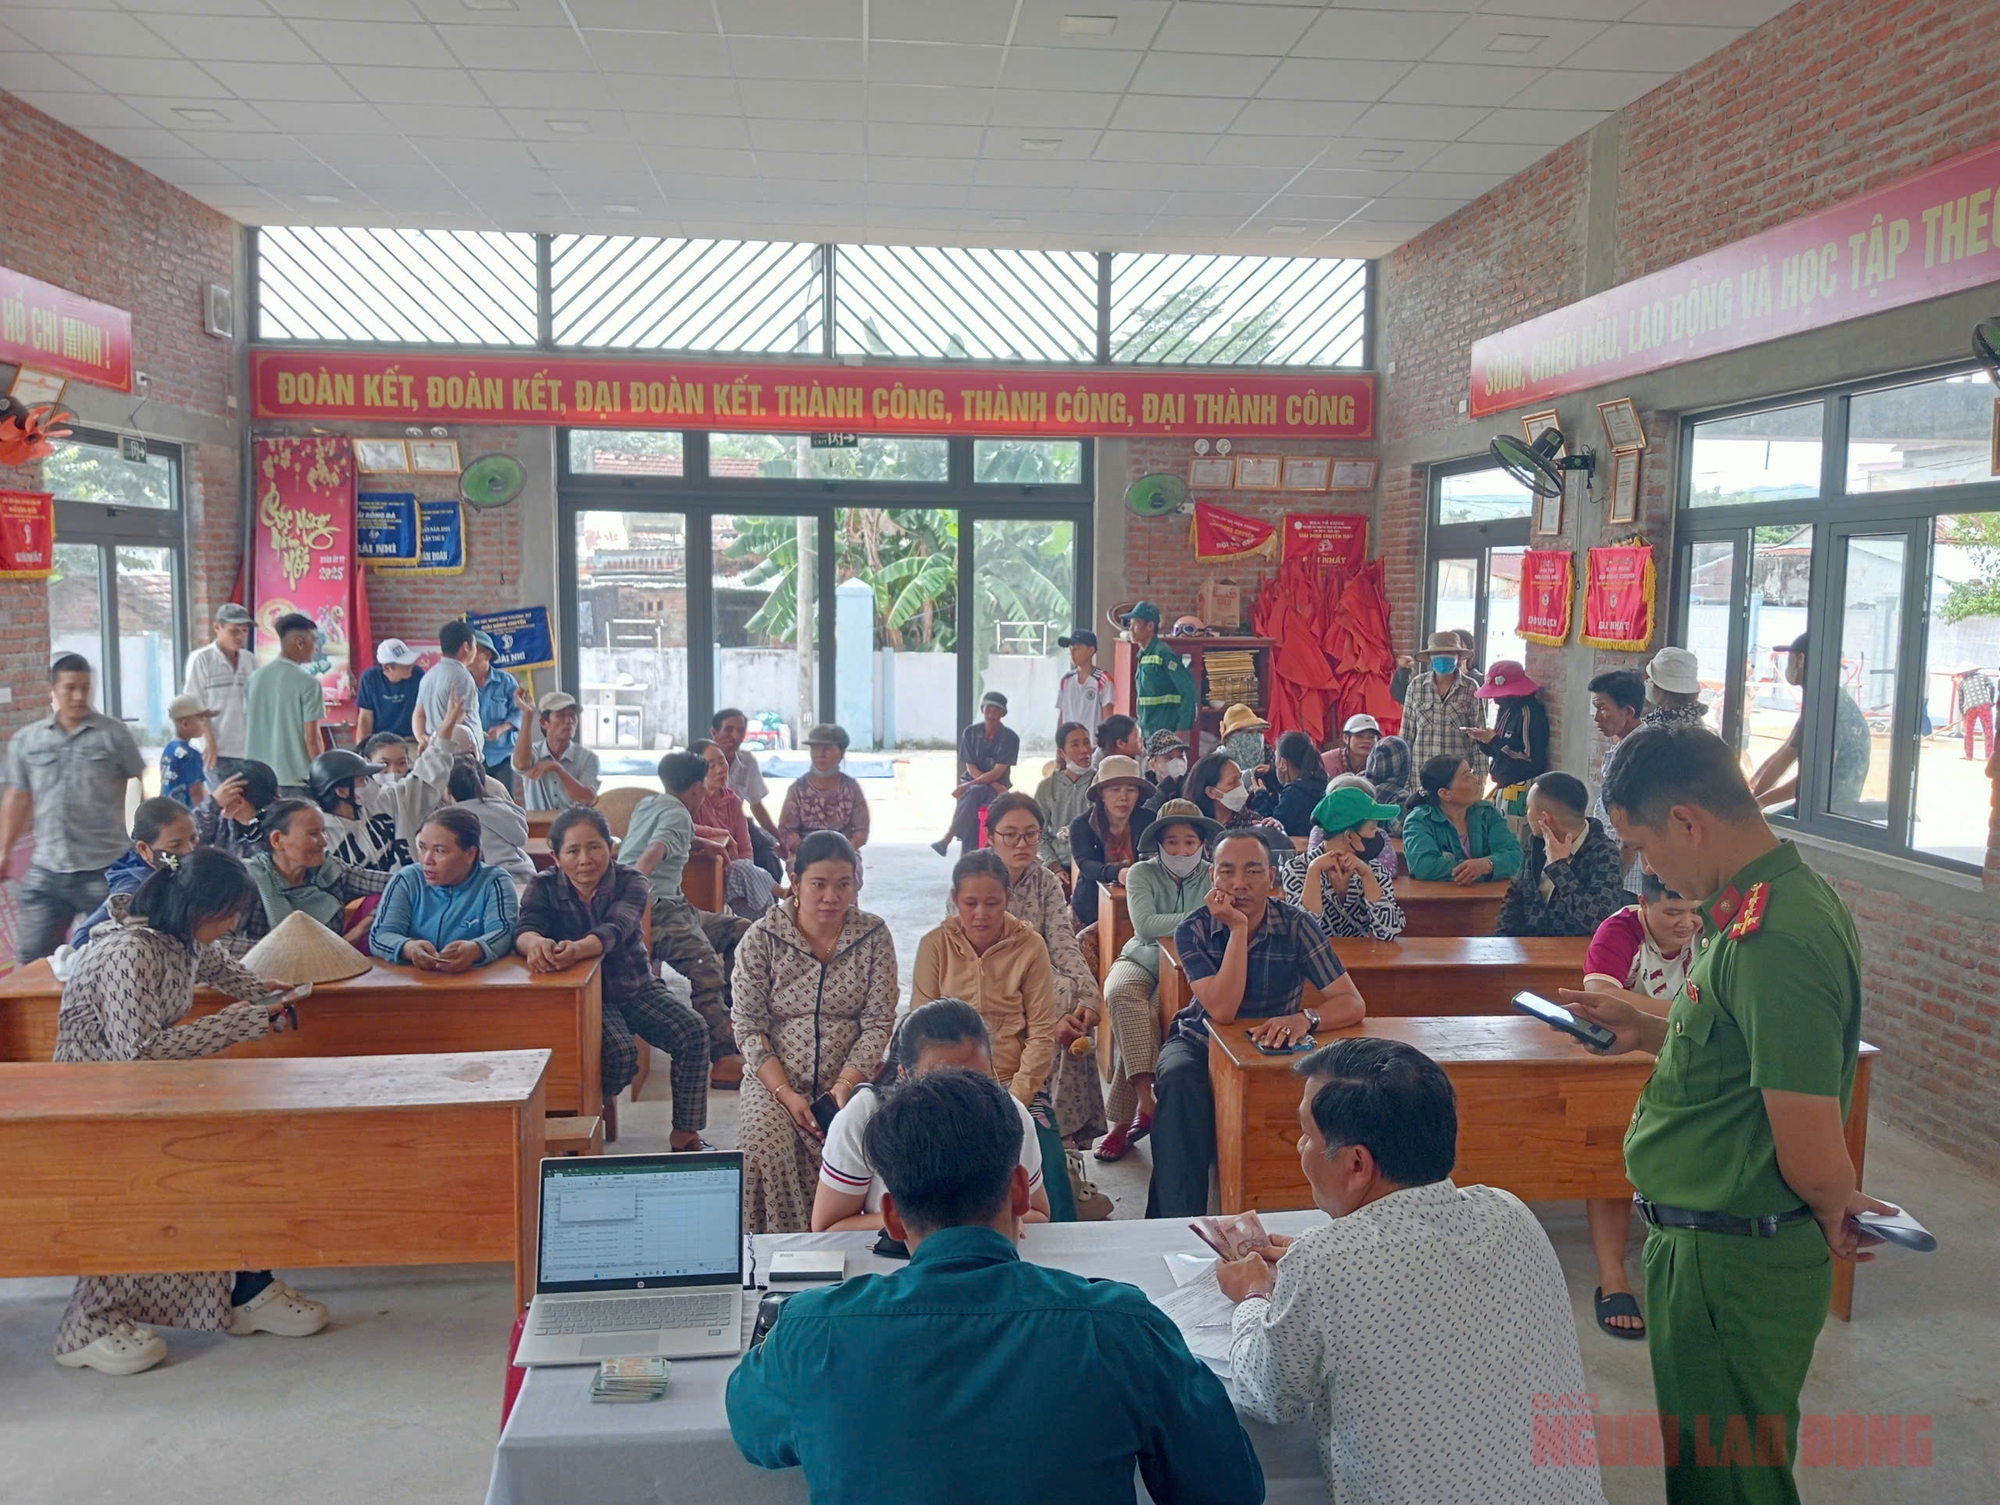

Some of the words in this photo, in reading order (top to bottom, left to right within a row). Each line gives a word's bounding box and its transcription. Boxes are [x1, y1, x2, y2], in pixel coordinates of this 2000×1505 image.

[1628, 301, 1665, 353] LAO
[1671, 277, 1734, 349] ĐỘNG
[1741, 253, 1772, 320] VÀ
[1781, 242, 1838, 315] HỌC
[1848, 213, 1910, 297] TẬP
[31, 304, 58, 355] CHÍ
[277, 366, 355, 406] ĐOÀN
[364, 364, 419, 411] KẾT,
[426, 370, 504, 410] ĐOÀN
[512, 369, 567, 415] KẾT,
[575, 379, 621, 419] ĐẠI
[629, 375, 704, 415] ĐOÀN
[713, 374, 767, 416] KẾT.
[775, 379, 863, 418] THÀNH
[872, 381, 953, 424] CÔNG,
[960, 384, 1047, 422] THÀNH
[1056, 386, 1134, 427] CÔNG,
[1142, 392, 1185, 430] ĐẠI
[1194, 387, 1277, 426] THÀNH
[1285, 388, 1355, 426] CÔNG
